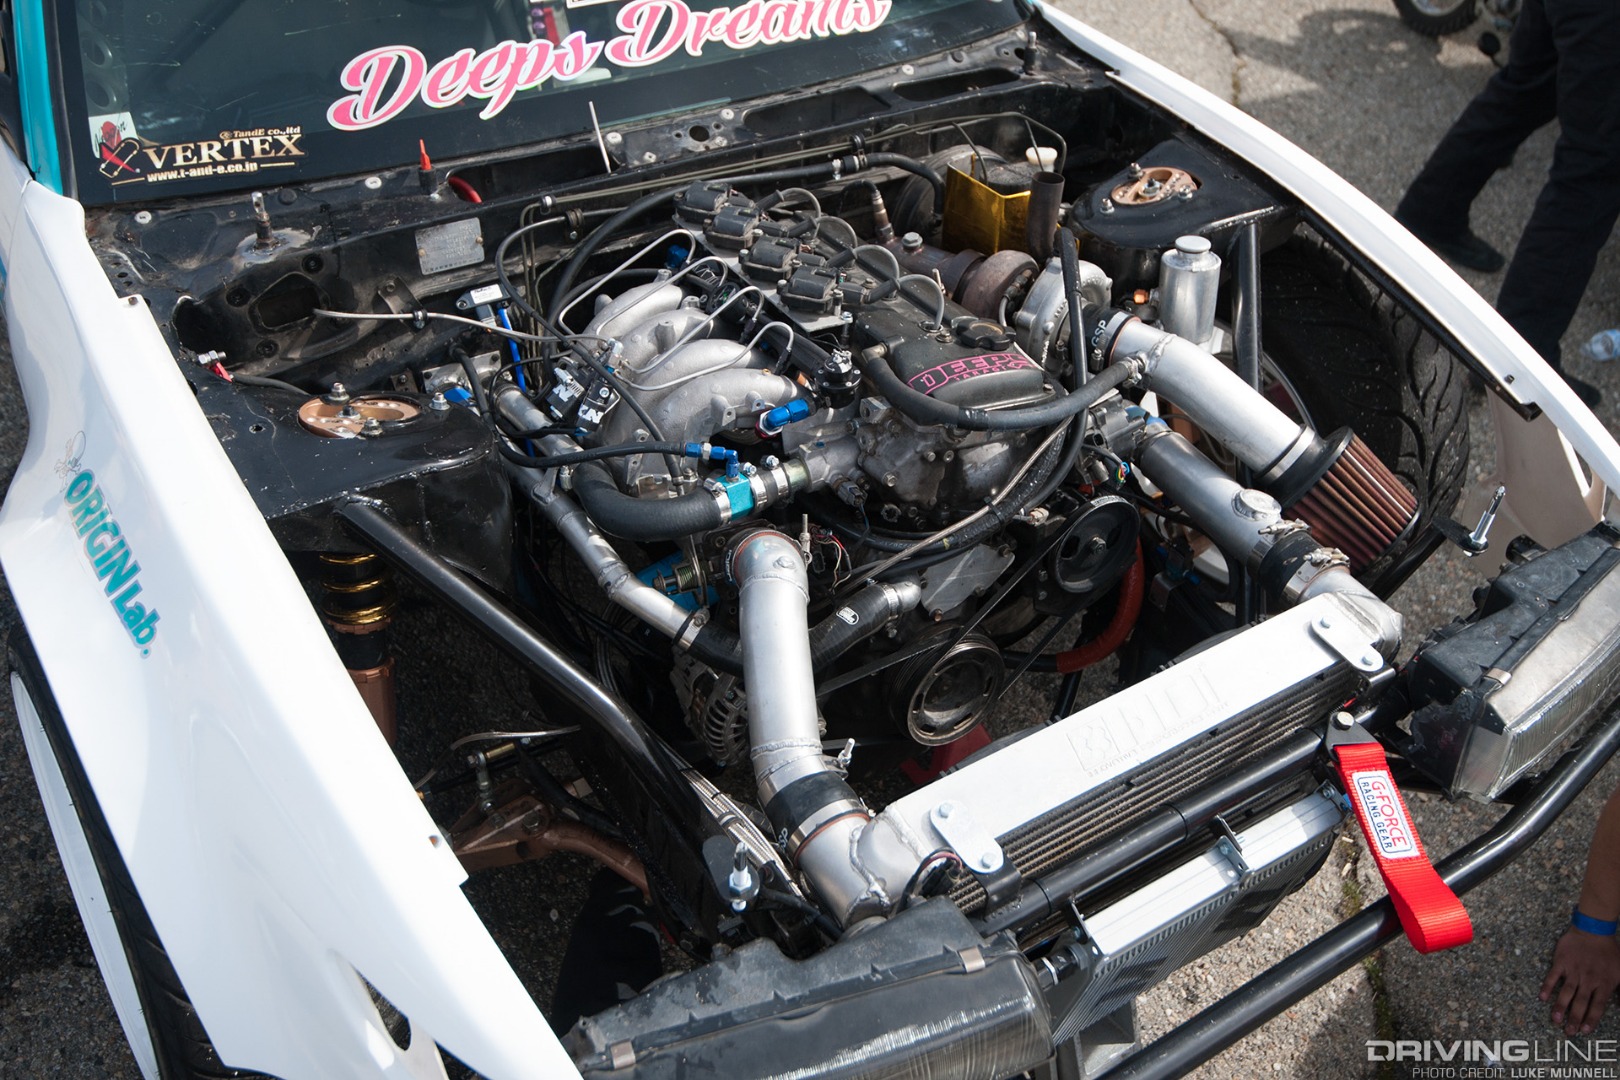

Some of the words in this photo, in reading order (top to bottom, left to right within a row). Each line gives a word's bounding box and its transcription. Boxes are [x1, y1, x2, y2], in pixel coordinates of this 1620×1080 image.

[327, 31, 604, 133] Deeps
[604, 0, 893, 67] Dreams
[143, 133, 305, 169] VERTEX
[232, 128, 265, 139] TandE
[147, 161, 258, 183] www.t-and-e.co.jp
[1091, 320, 1107, 347] GSP
[64, 469, 142, 598] ORIGIN
[1360, 781, 1381, 818] RACING
[1376, 821, 1393, 849] GEAR
[1371, 780, 1408, 847] G-FORCE
